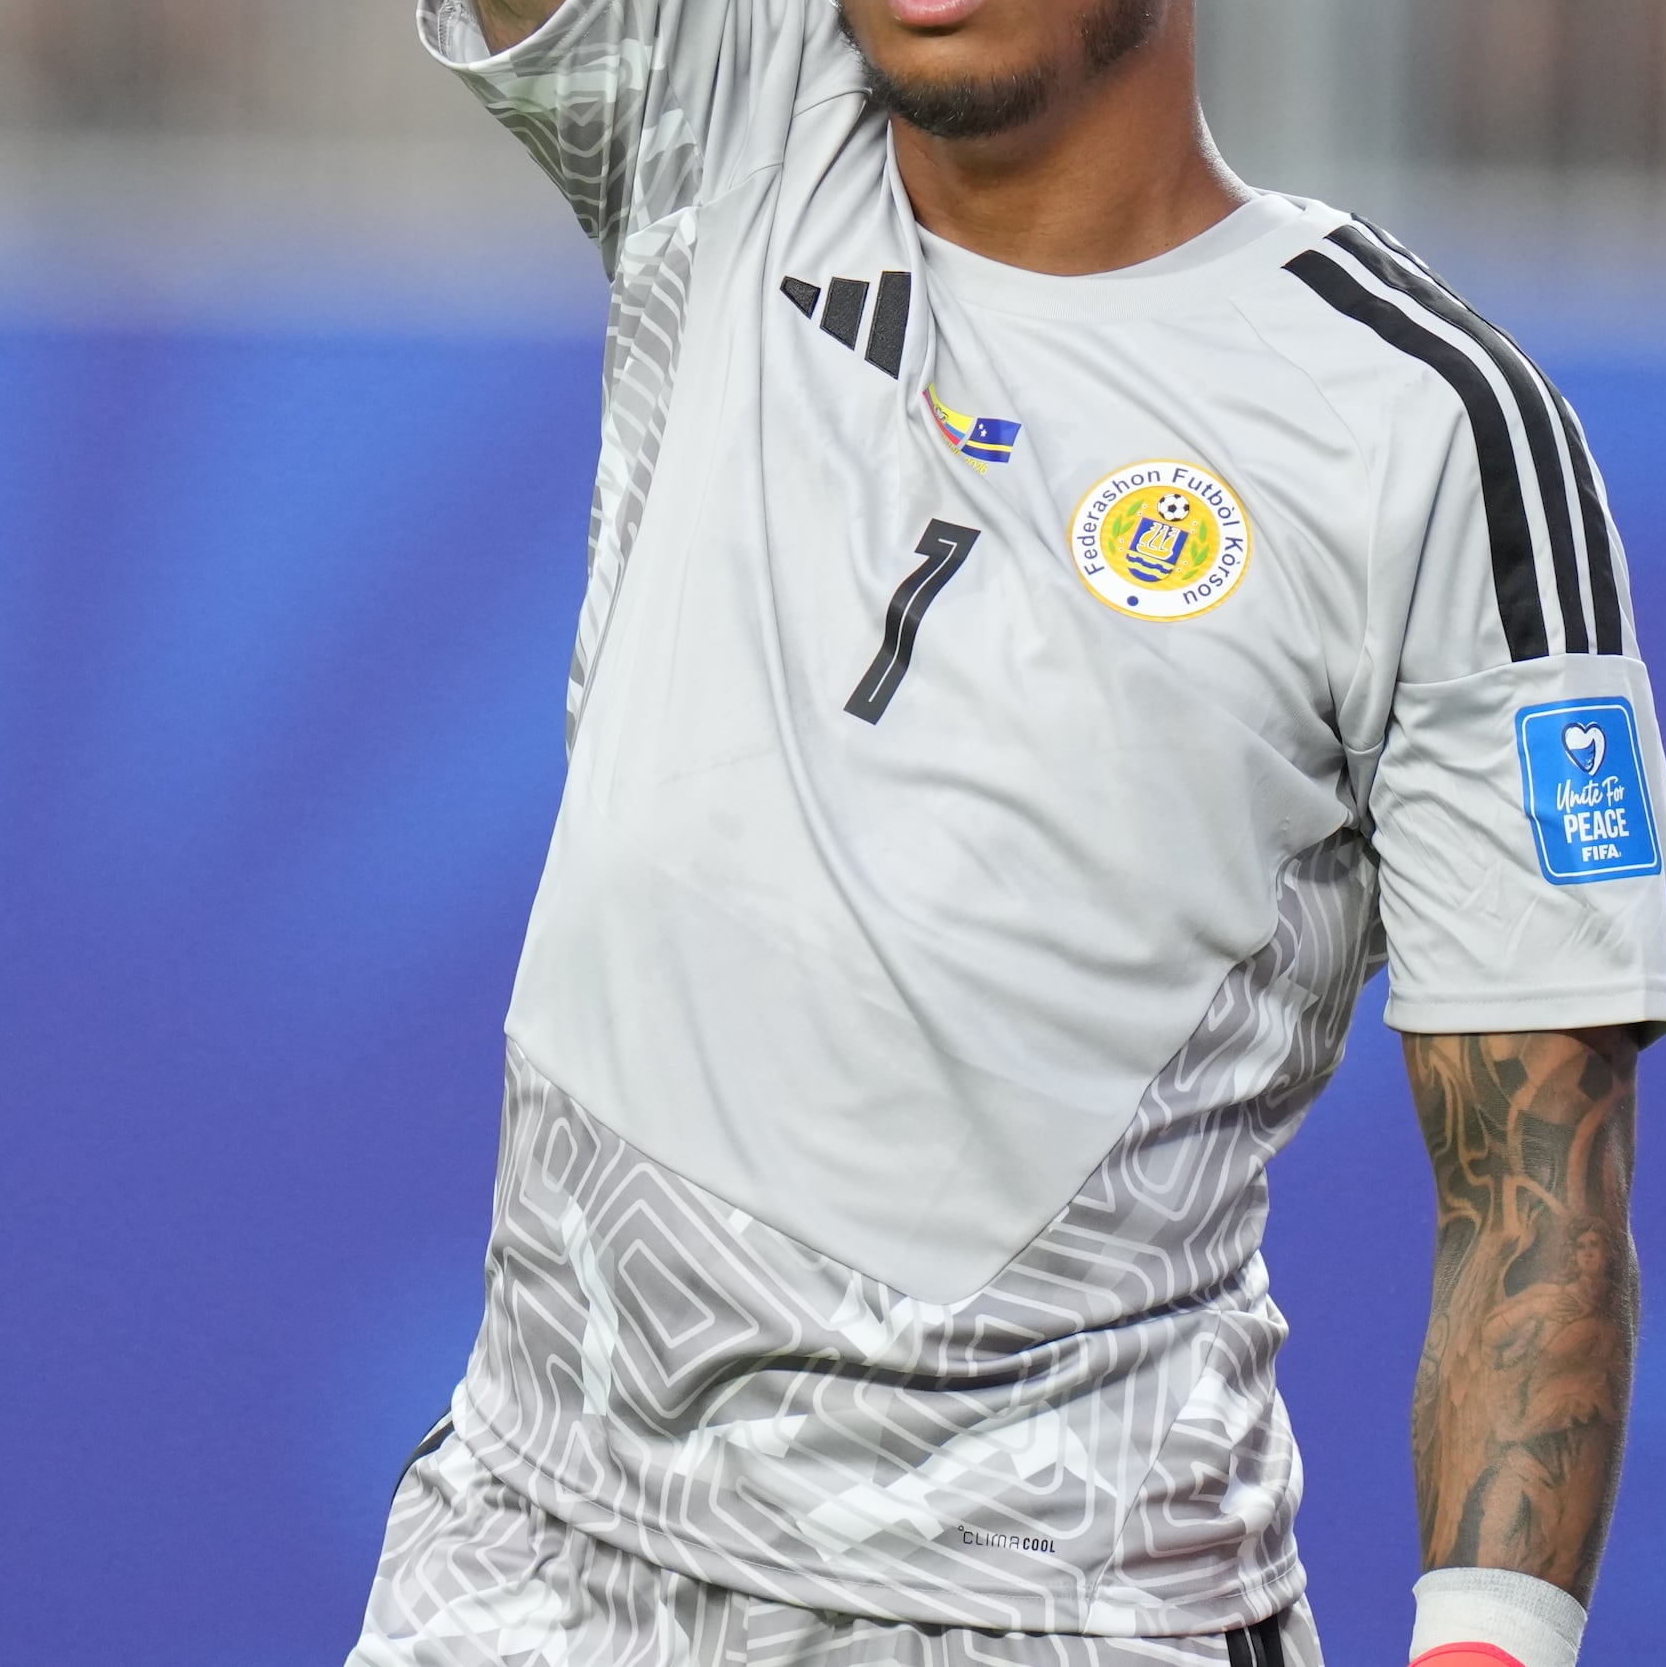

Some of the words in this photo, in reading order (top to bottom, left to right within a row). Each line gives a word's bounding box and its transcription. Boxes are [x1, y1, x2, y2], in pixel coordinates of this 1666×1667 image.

[1077, 469, 1161, 576] Federashon
[1556, 779, 1603, 813] Unite
[1602, 775, 1625, 808] For
[1563, 808, 1629, 844] PEACE
[1581, 843, 1620, 862] FIFA
